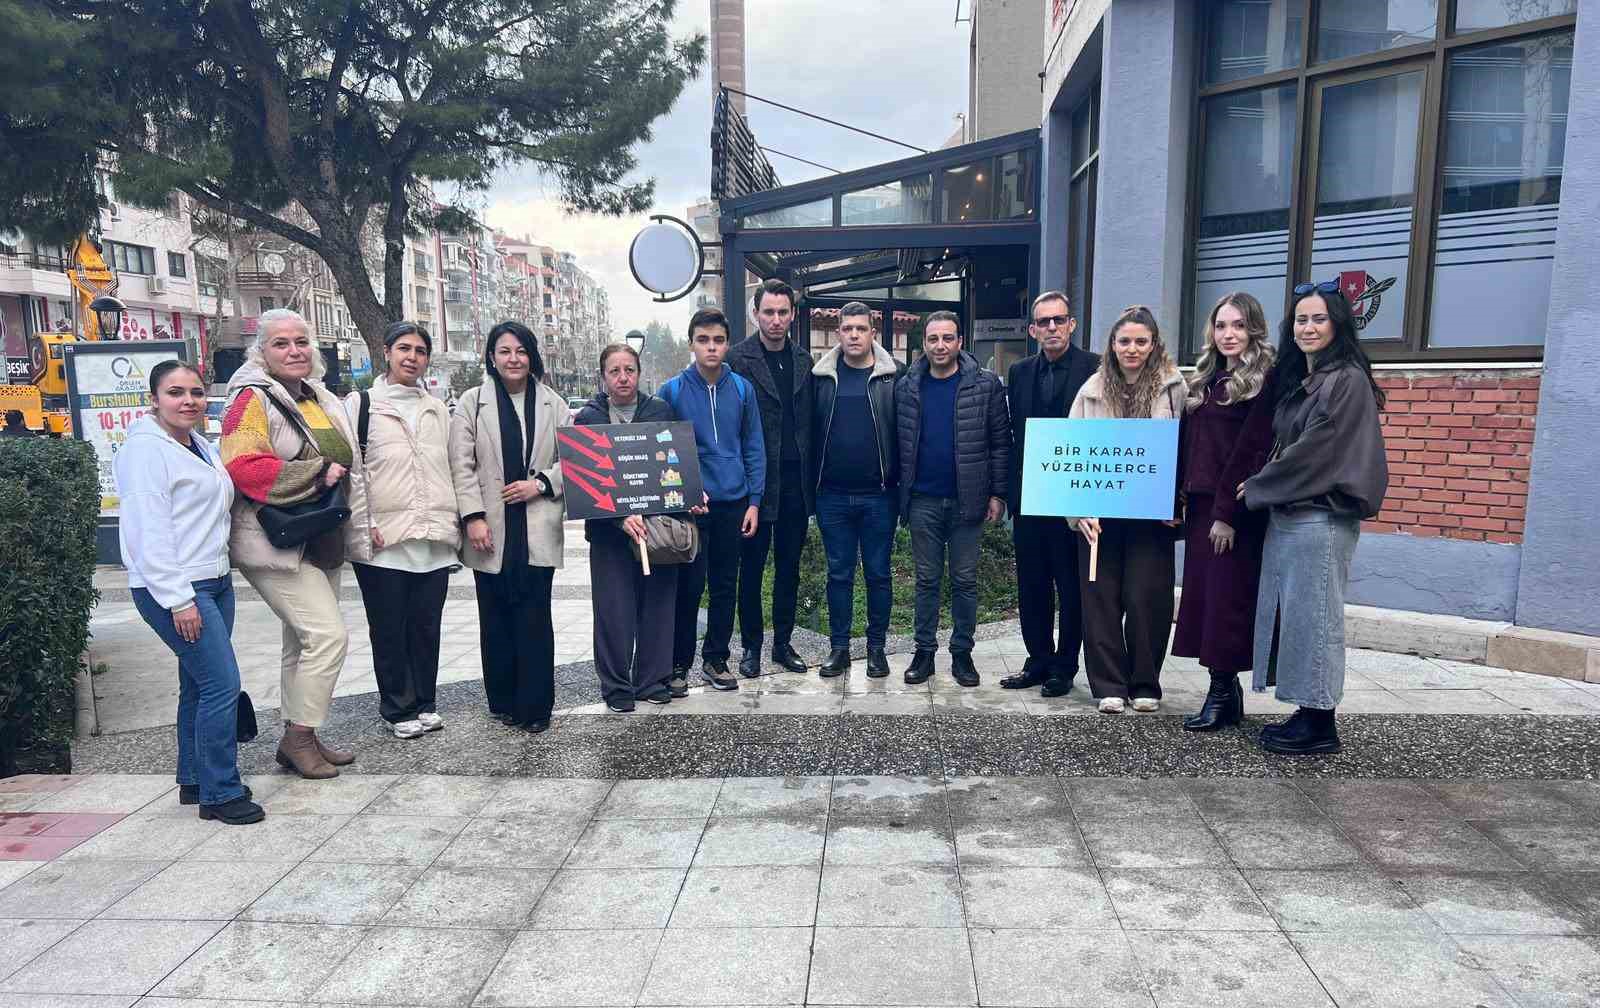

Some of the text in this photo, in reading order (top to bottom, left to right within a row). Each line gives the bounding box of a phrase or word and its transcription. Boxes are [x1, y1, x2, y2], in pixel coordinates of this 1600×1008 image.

[1054, 444, 1146, 456] BİR KARAR
[1041, 460, 1157, 474] YÜZBİNLERCE
[1070, 479, 1126, 489] HAYAT
